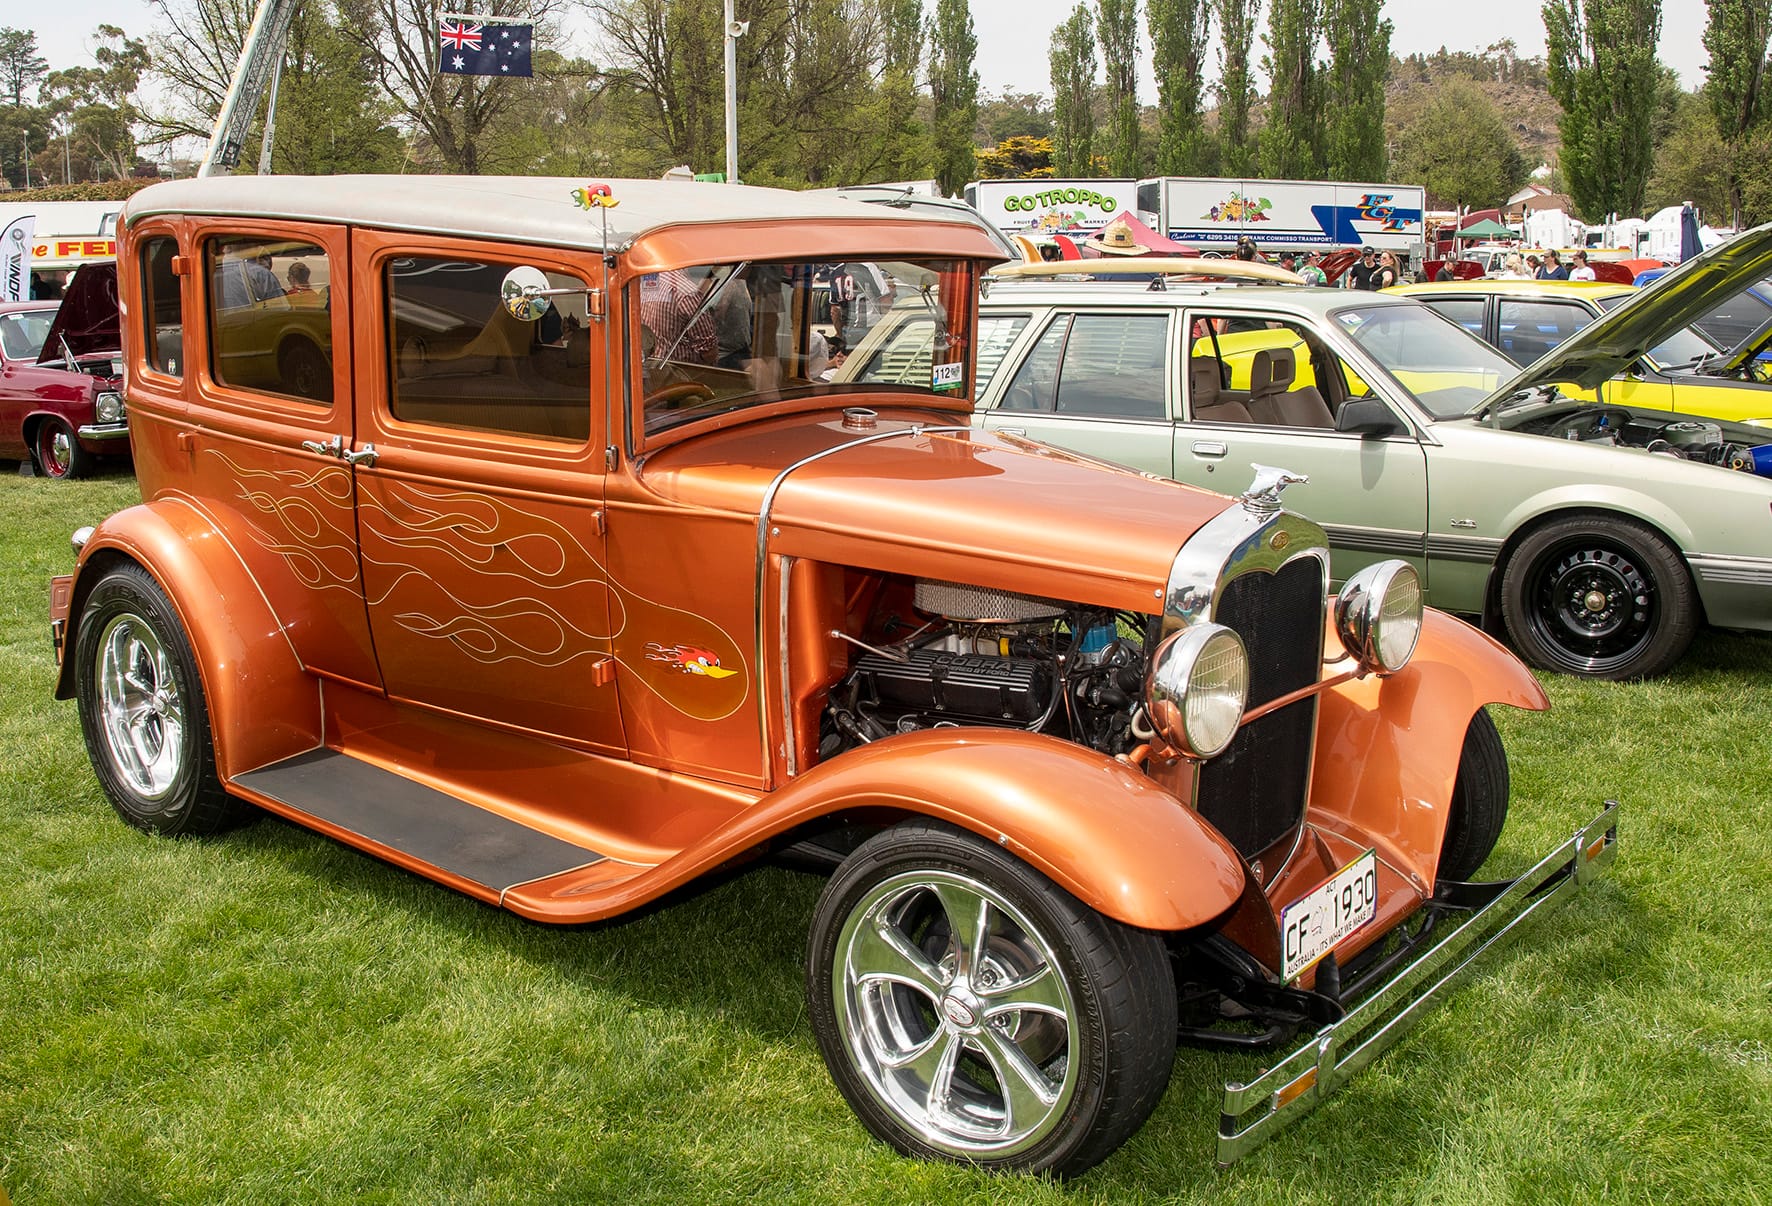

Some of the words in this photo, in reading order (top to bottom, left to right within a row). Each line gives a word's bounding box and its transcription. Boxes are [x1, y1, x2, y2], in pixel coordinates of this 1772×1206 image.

[1004, 195, 1036, 212] GO
[1036, 187, 1117, 212] TROPPO
[1298, 235, 1333, 243] TRANSPORT
[935, 367, 950, 380] 112
[936, 655, 1011, 671] COBRA
[1326, 880, 1337, 895] ACT
[1286, 913, 1310, 962] CF
[1333, 869, 1374, 929] 1930
[1287, 948, 1316, 976] AUSTRALIA
[1329, 927, 1344, 945] WHAT
